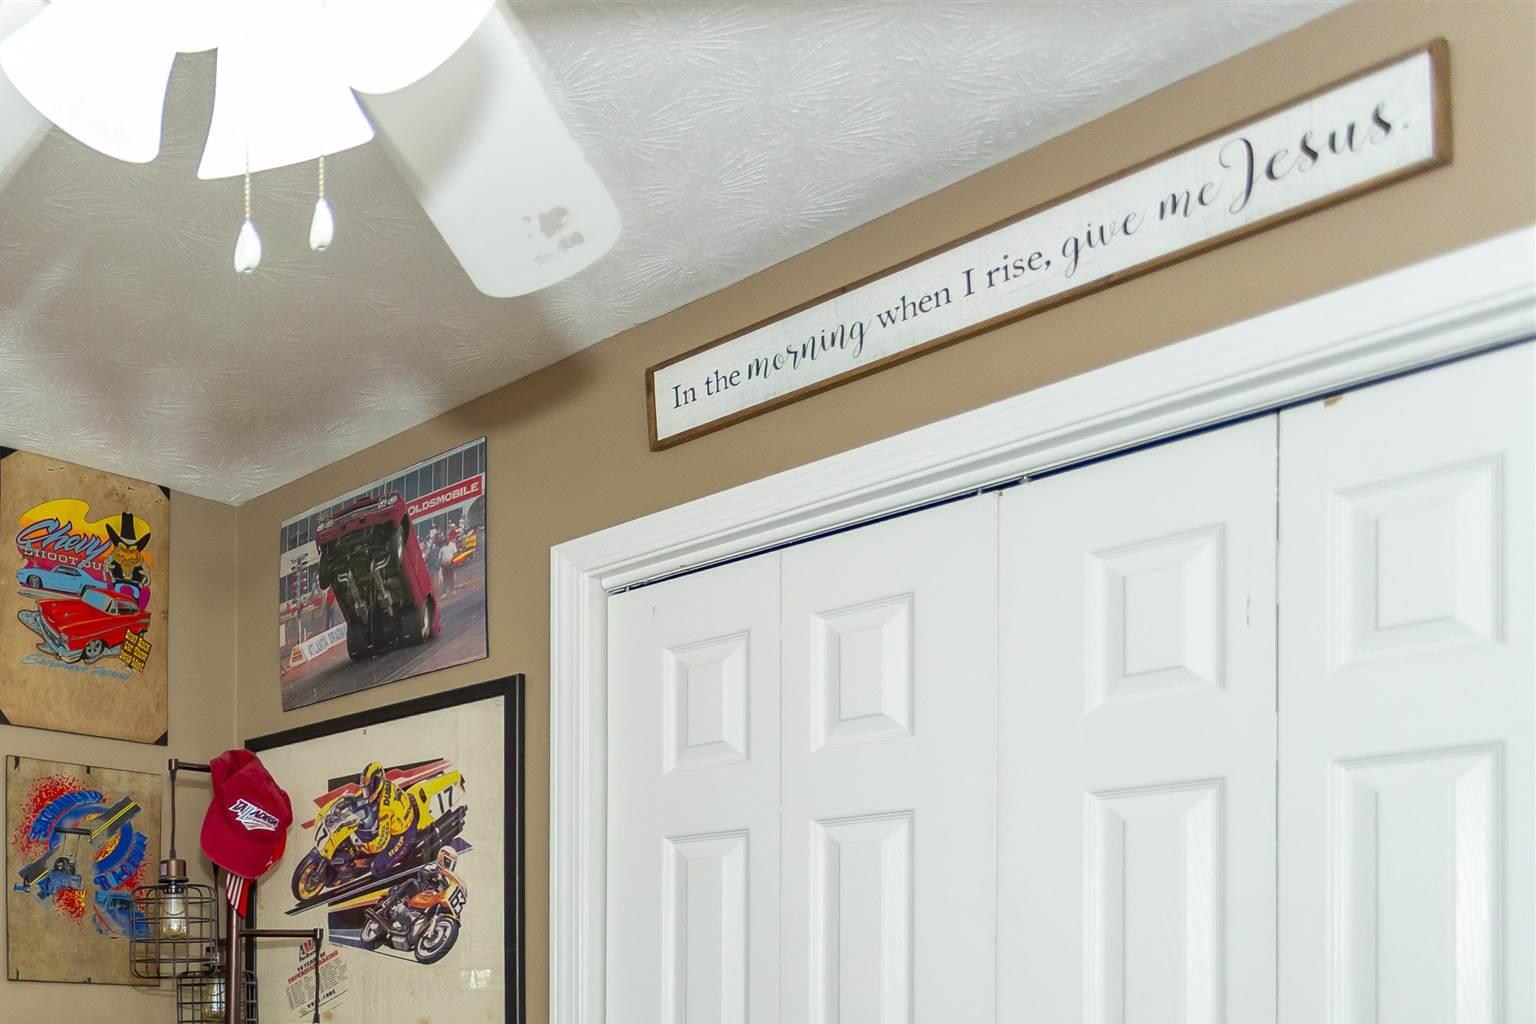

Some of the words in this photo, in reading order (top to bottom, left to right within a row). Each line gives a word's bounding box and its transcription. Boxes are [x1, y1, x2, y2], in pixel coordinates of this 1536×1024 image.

[671, 383, 697, 409] In
[704, 367, 742, 398] the
[746, 313, 872, 381] morning
[876, 284, 953, 329] when
[961, 268, 978, 298] I
[986, 252, 1052, 289] rise,
[1061, 209, 1146, 279] give
[1159, 180, 1221, 223] me
[1217, 99, 1411, 216] Jesus.
[408, 481, 480, 517] OLDSMOBILE
[17, 517, 112, 562] Chevy
[24, 547, 79, 567] SHOOT
[437, 786, 454, 814] 17
